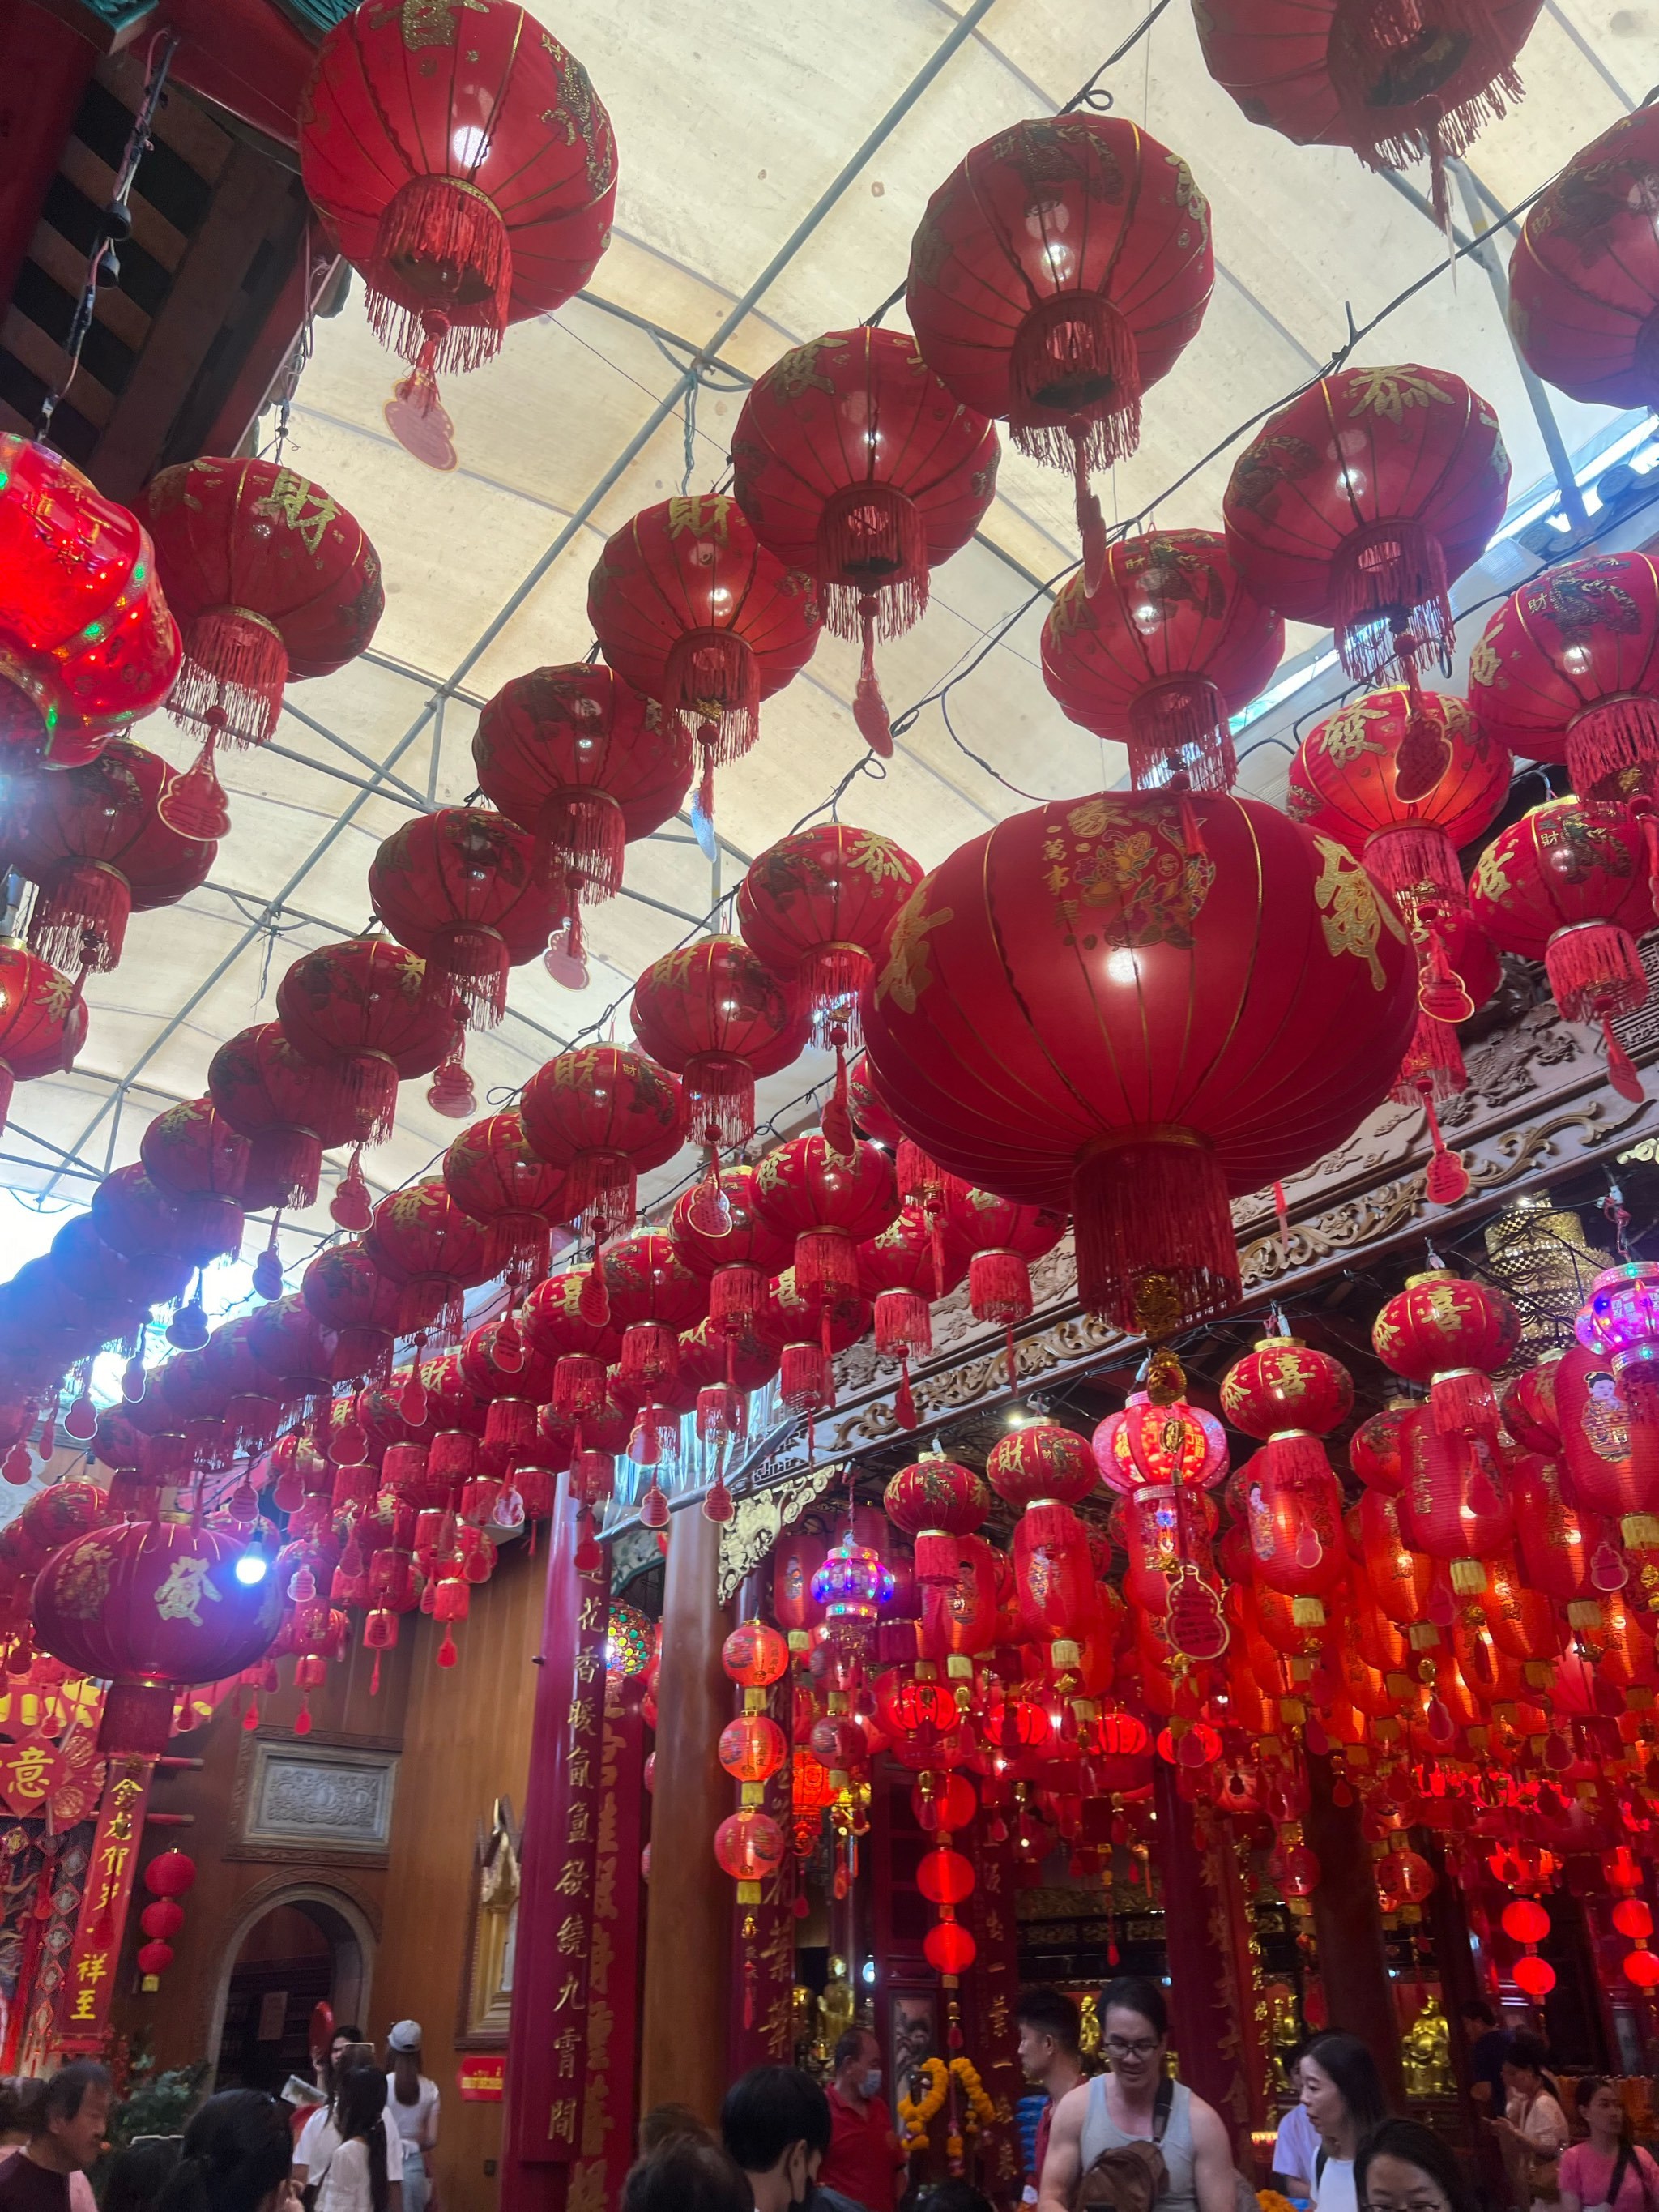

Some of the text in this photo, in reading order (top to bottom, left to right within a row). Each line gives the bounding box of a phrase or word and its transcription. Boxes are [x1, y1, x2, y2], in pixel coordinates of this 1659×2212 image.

[1350, 367, 1455, 424] 恭
[254, 468, 339, 554] 財
[667, 494, 731, 547] 財
[1124, 557, 1145, 575] 財
[1526, 592, 1549, 616] 財
[1318, 701, 1391, 771] 發
[847, 831, 914, 885] 恭
[1540, 829, 1560, 848] 財
[650, 944, 701, 993] 財
[554, 1049, 599, 1091] 財
[756, 1144, 793, 1197] 發
[1421, 1286, 1473, 1334] 喜
[420, 1358, 450, 1394] 財
[1269, 1352, 1315, 1397] 喜
[997, 1437, 1024, 1476] 財
[8, 1745, 57, 1801] 意
